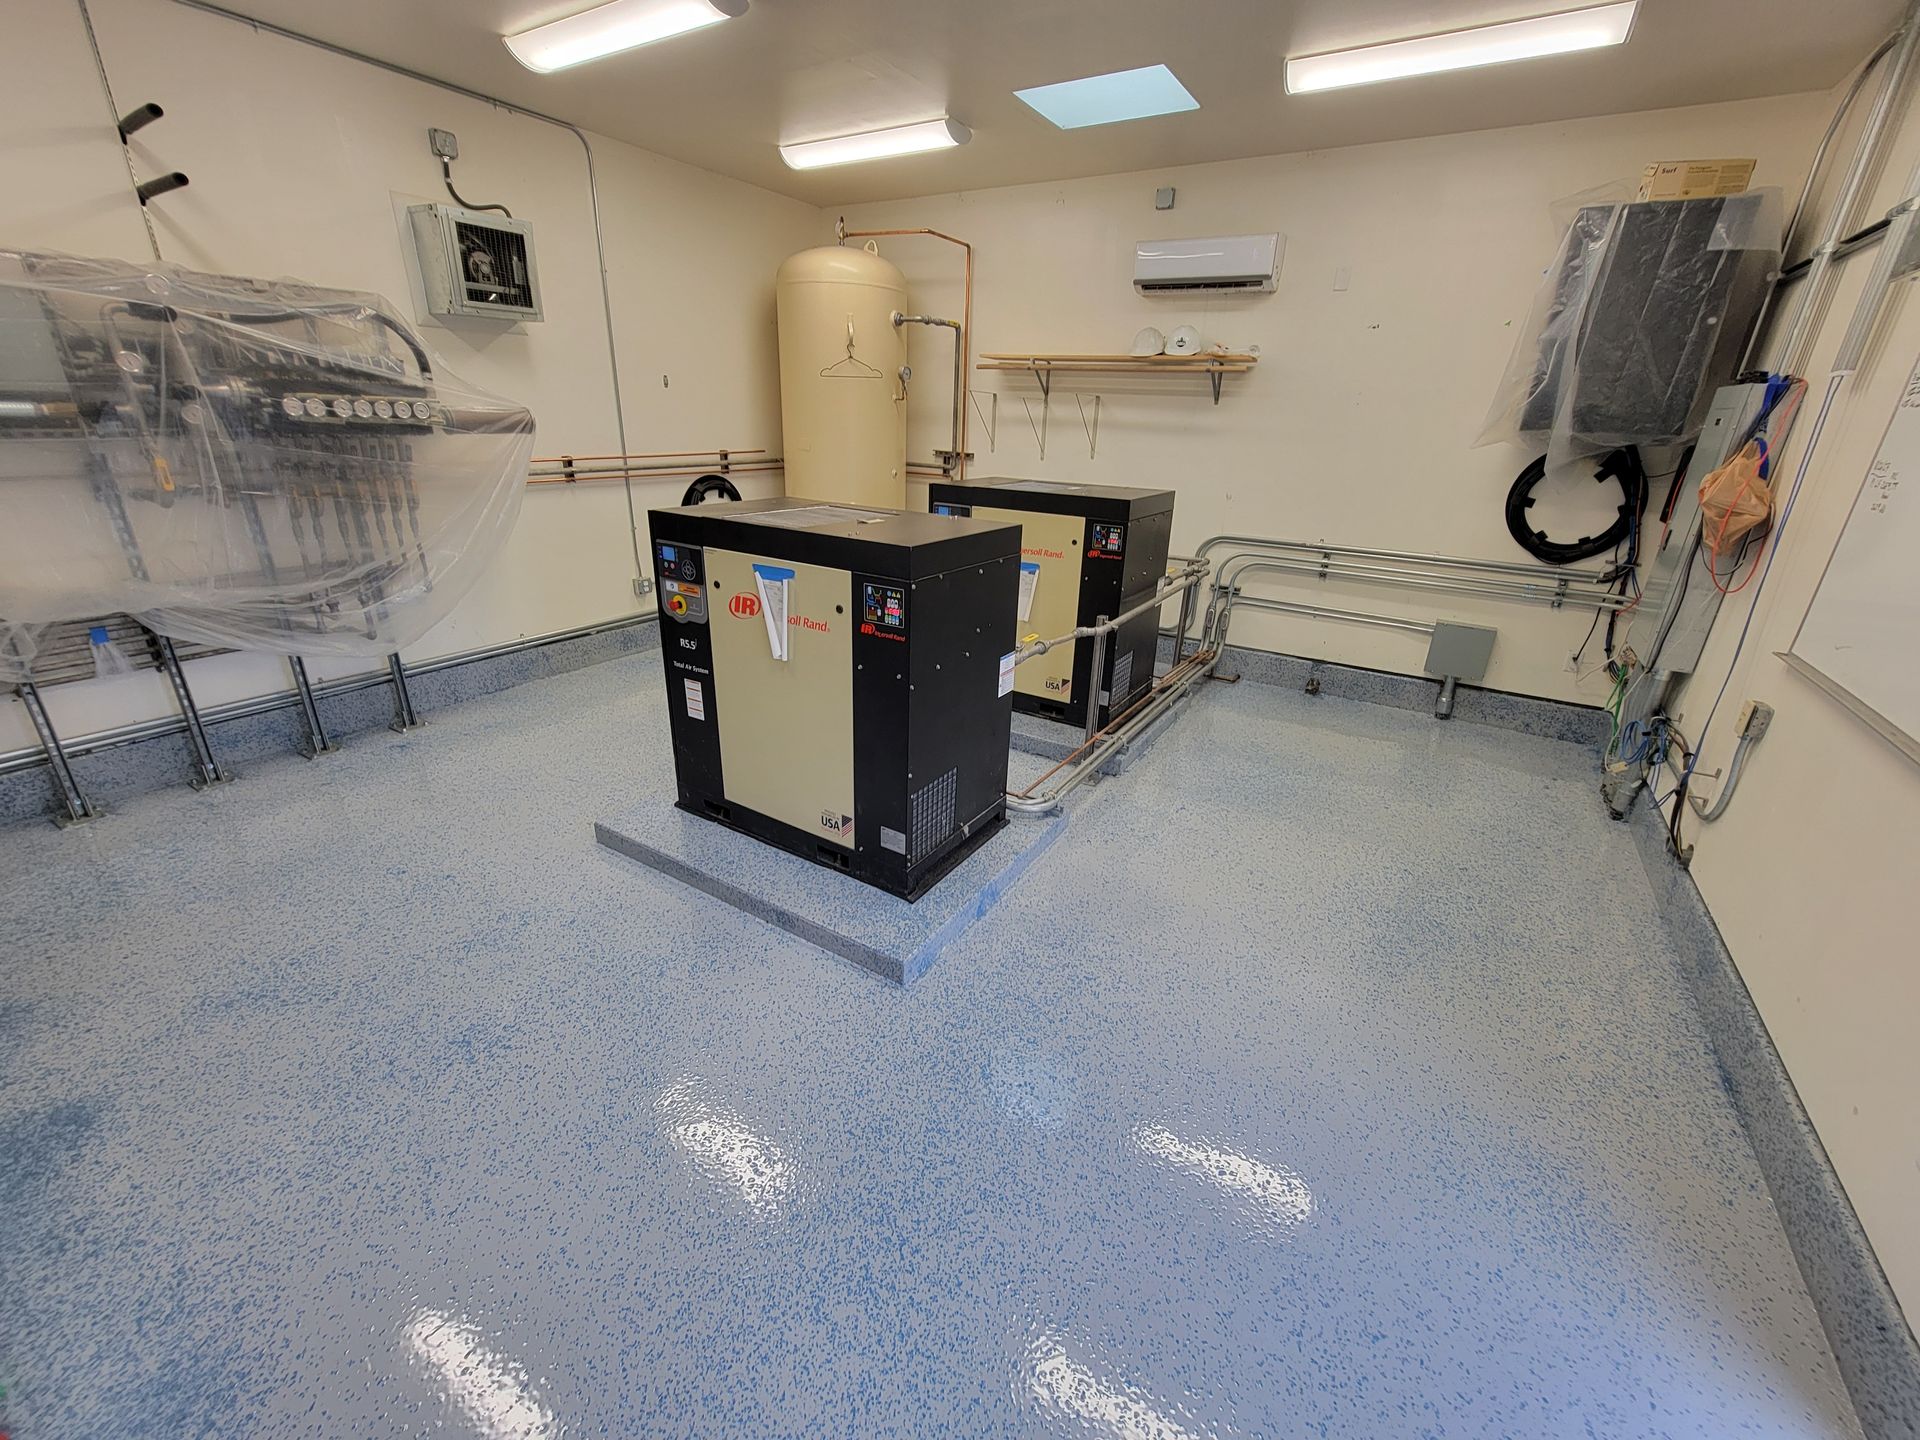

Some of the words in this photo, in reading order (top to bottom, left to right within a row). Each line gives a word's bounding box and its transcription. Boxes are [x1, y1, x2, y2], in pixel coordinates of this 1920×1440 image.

[1661, 166, 1678, 175] Surf
[733, 594, 757, 617] IR
[673, 660, 685, 669] Total
[693, 665, 709, 675] System
[1045, 681, 1060, 691] USA
[821, 815, 840, 831] USA
